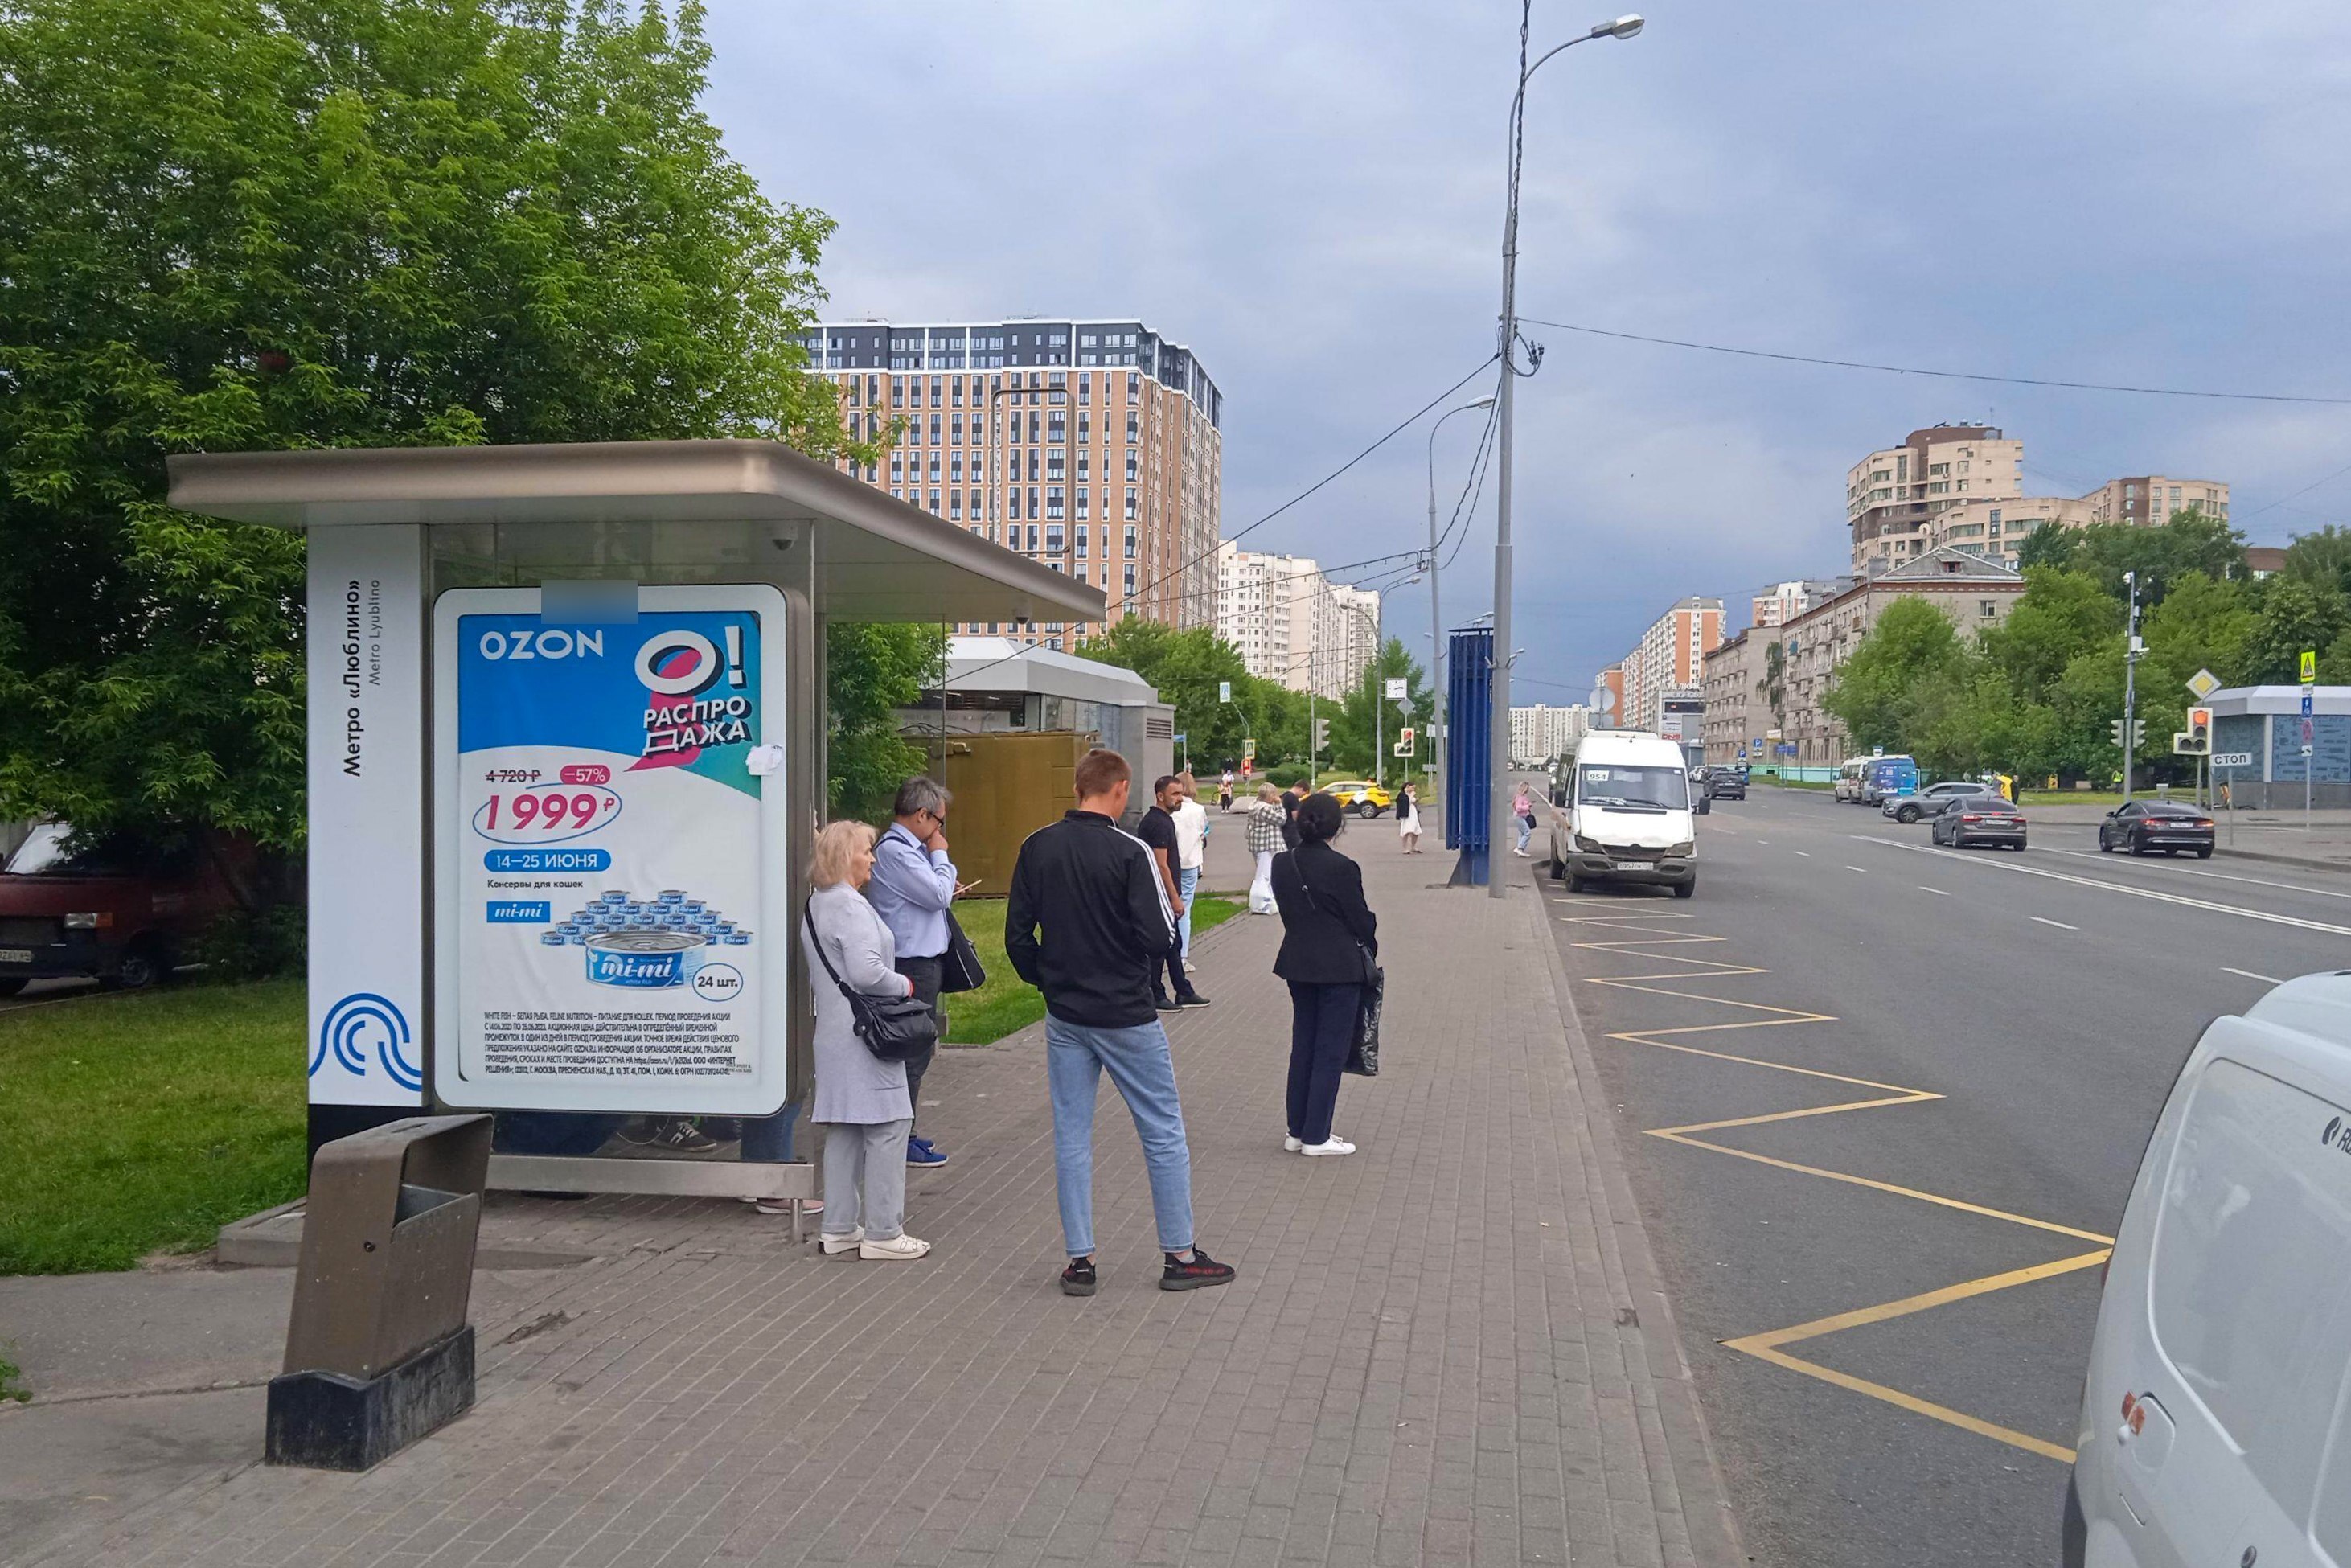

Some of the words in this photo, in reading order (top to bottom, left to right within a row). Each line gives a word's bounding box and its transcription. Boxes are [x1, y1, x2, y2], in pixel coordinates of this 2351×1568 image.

[368, 580, 383, 638] Lyublino
[343, 580, 360, 699] «Люблино»
[480, 629, 604, 660] OZON
[369, 644, 380, 686] Metro
[644, 696, 746, 729] РАСПРО
[343, 708, 364, 778] Метро
[642, 720, 746, 756] ДАЖА
[2214, 755, 2246, 764] СТОП
[497, 855, 540, 868] 14–25
[545, 853, 597, 868] ИЮНЯ
[487, 880, 531, 889] Консервы
[534, 881, 551, 889] для
[494, 903, 543, 917] mi-mi
[601, 956, 674, 978] mi-mi
[698, 976, 713, 987] 24
[717, 978, 738, 987] шт.
[693, 1057, 706, 1065] ООО
